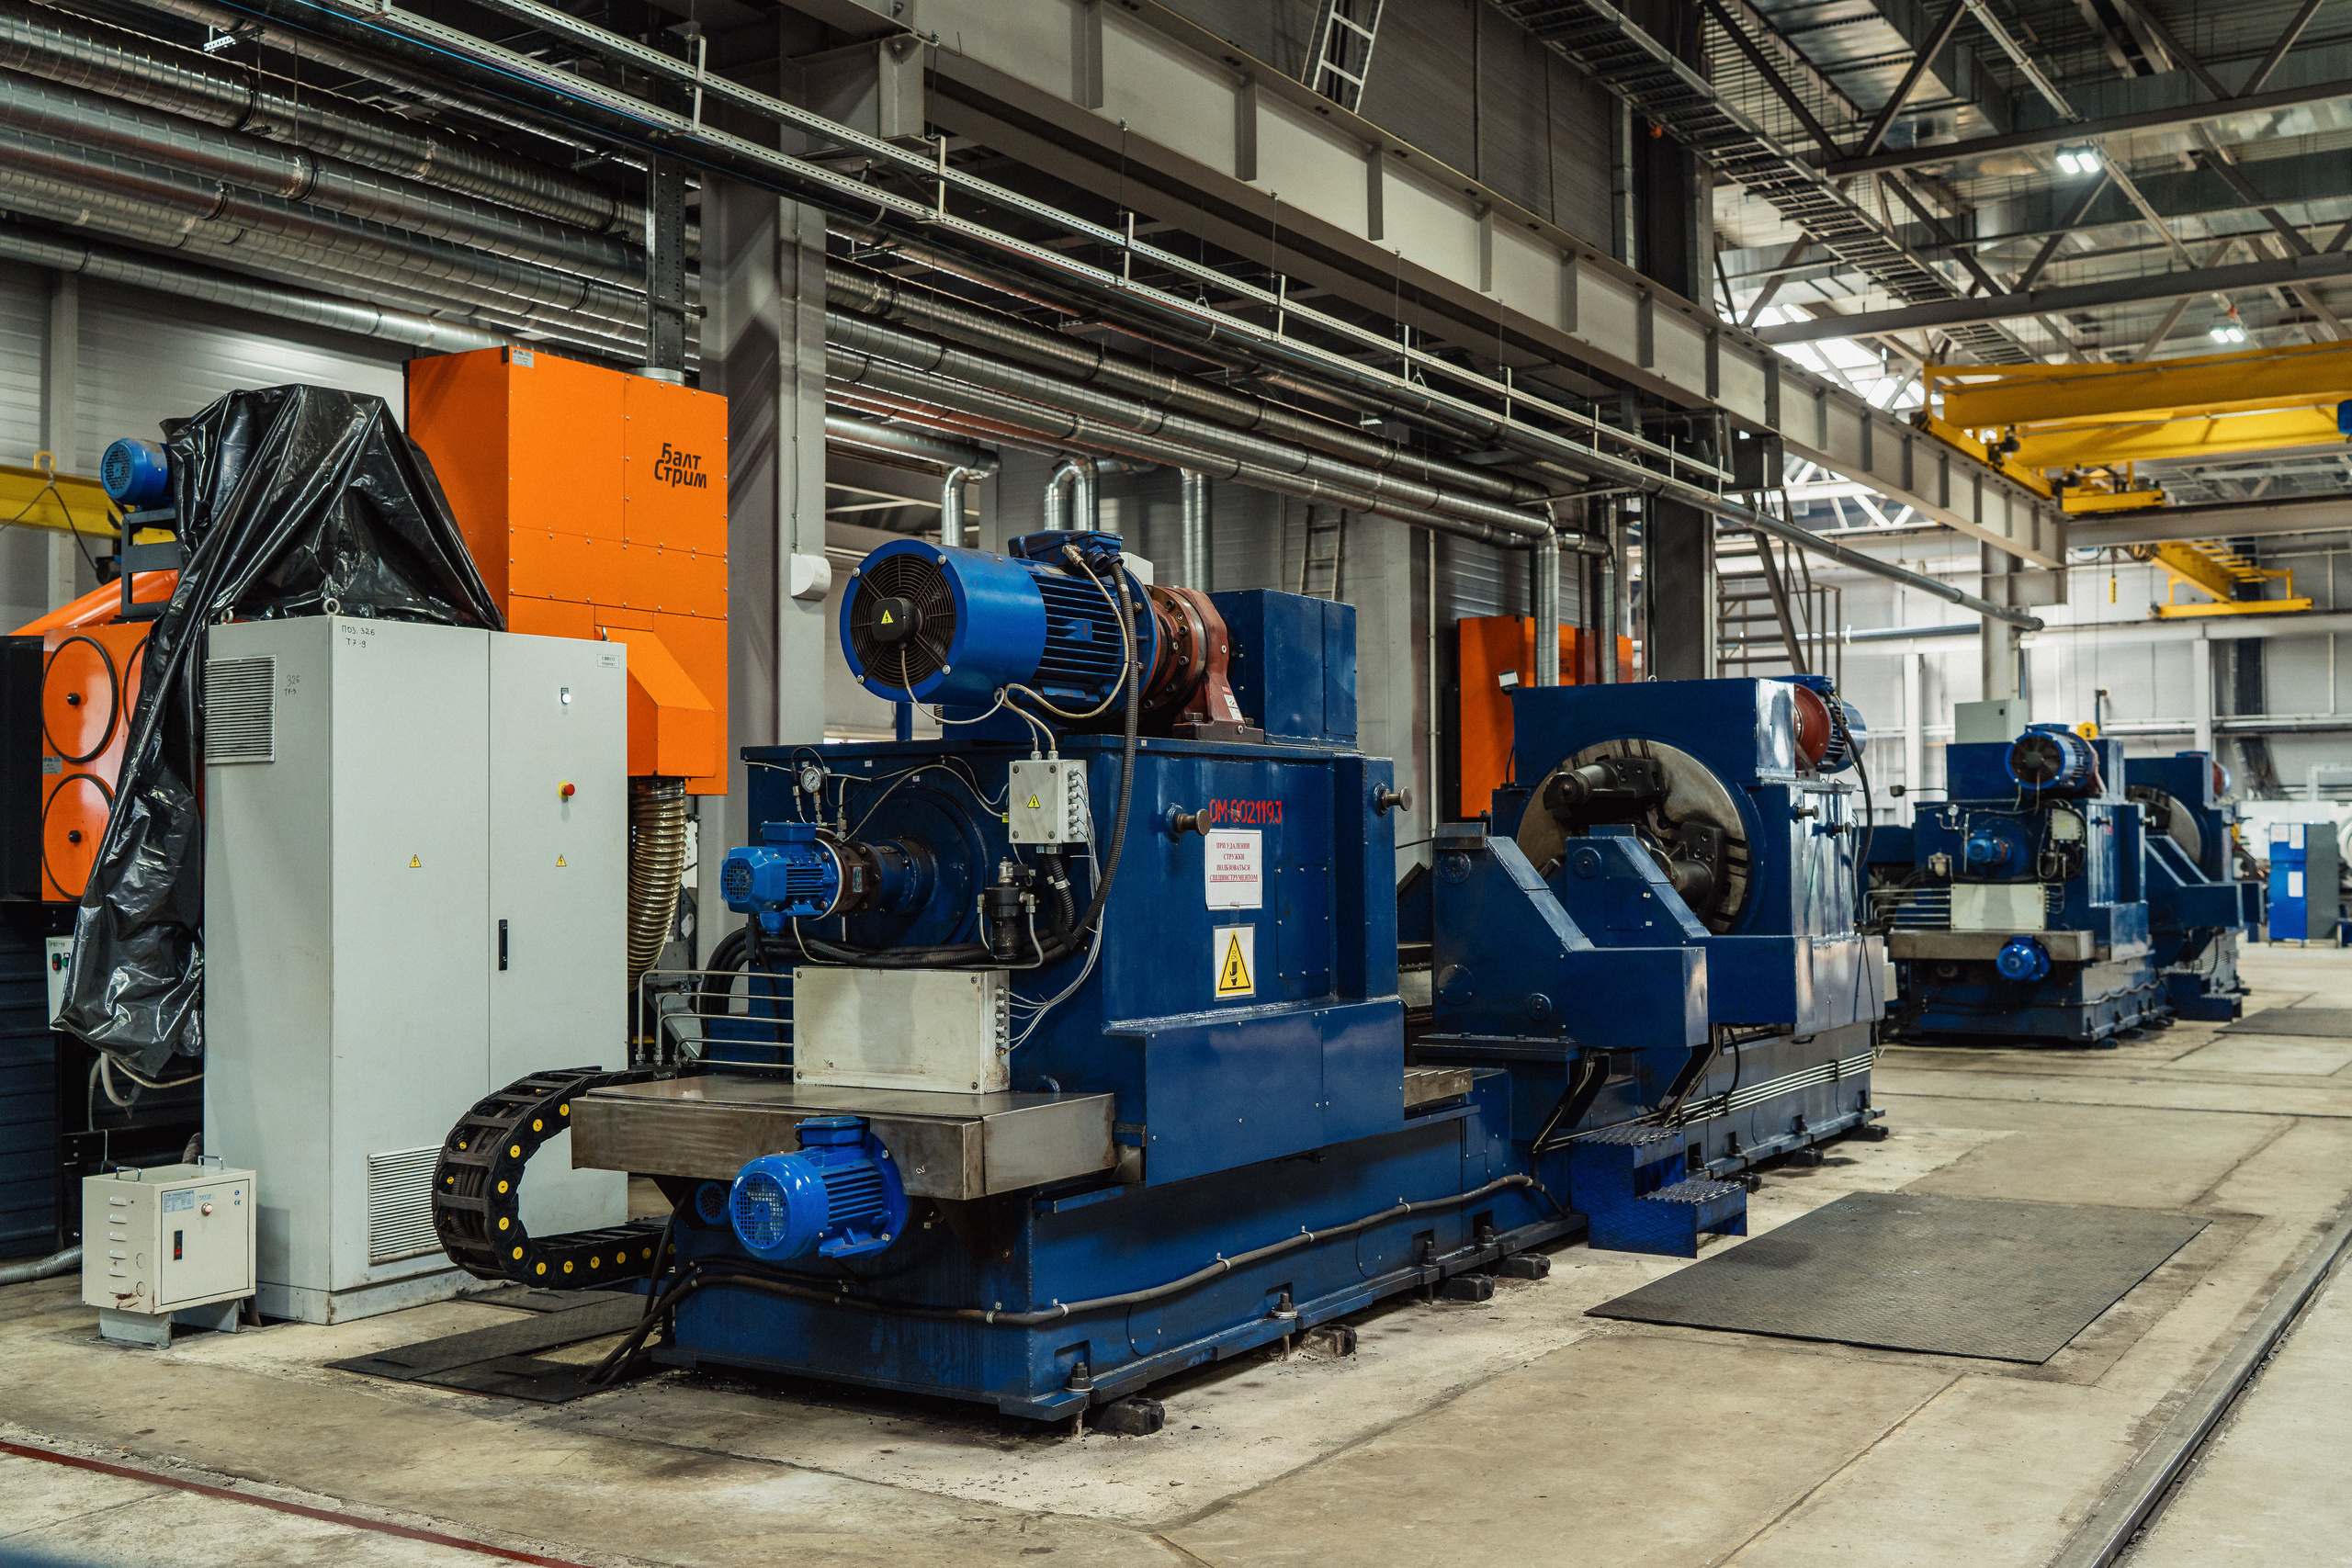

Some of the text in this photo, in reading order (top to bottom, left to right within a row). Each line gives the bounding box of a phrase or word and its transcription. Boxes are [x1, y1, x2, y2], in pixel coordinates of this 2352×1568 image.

[662, 442, 702, 470] Балт
[654, 458, 707, 489] Стрим
[360, 627, 376, 637] 326
[286, 674, 301, 687] 326
